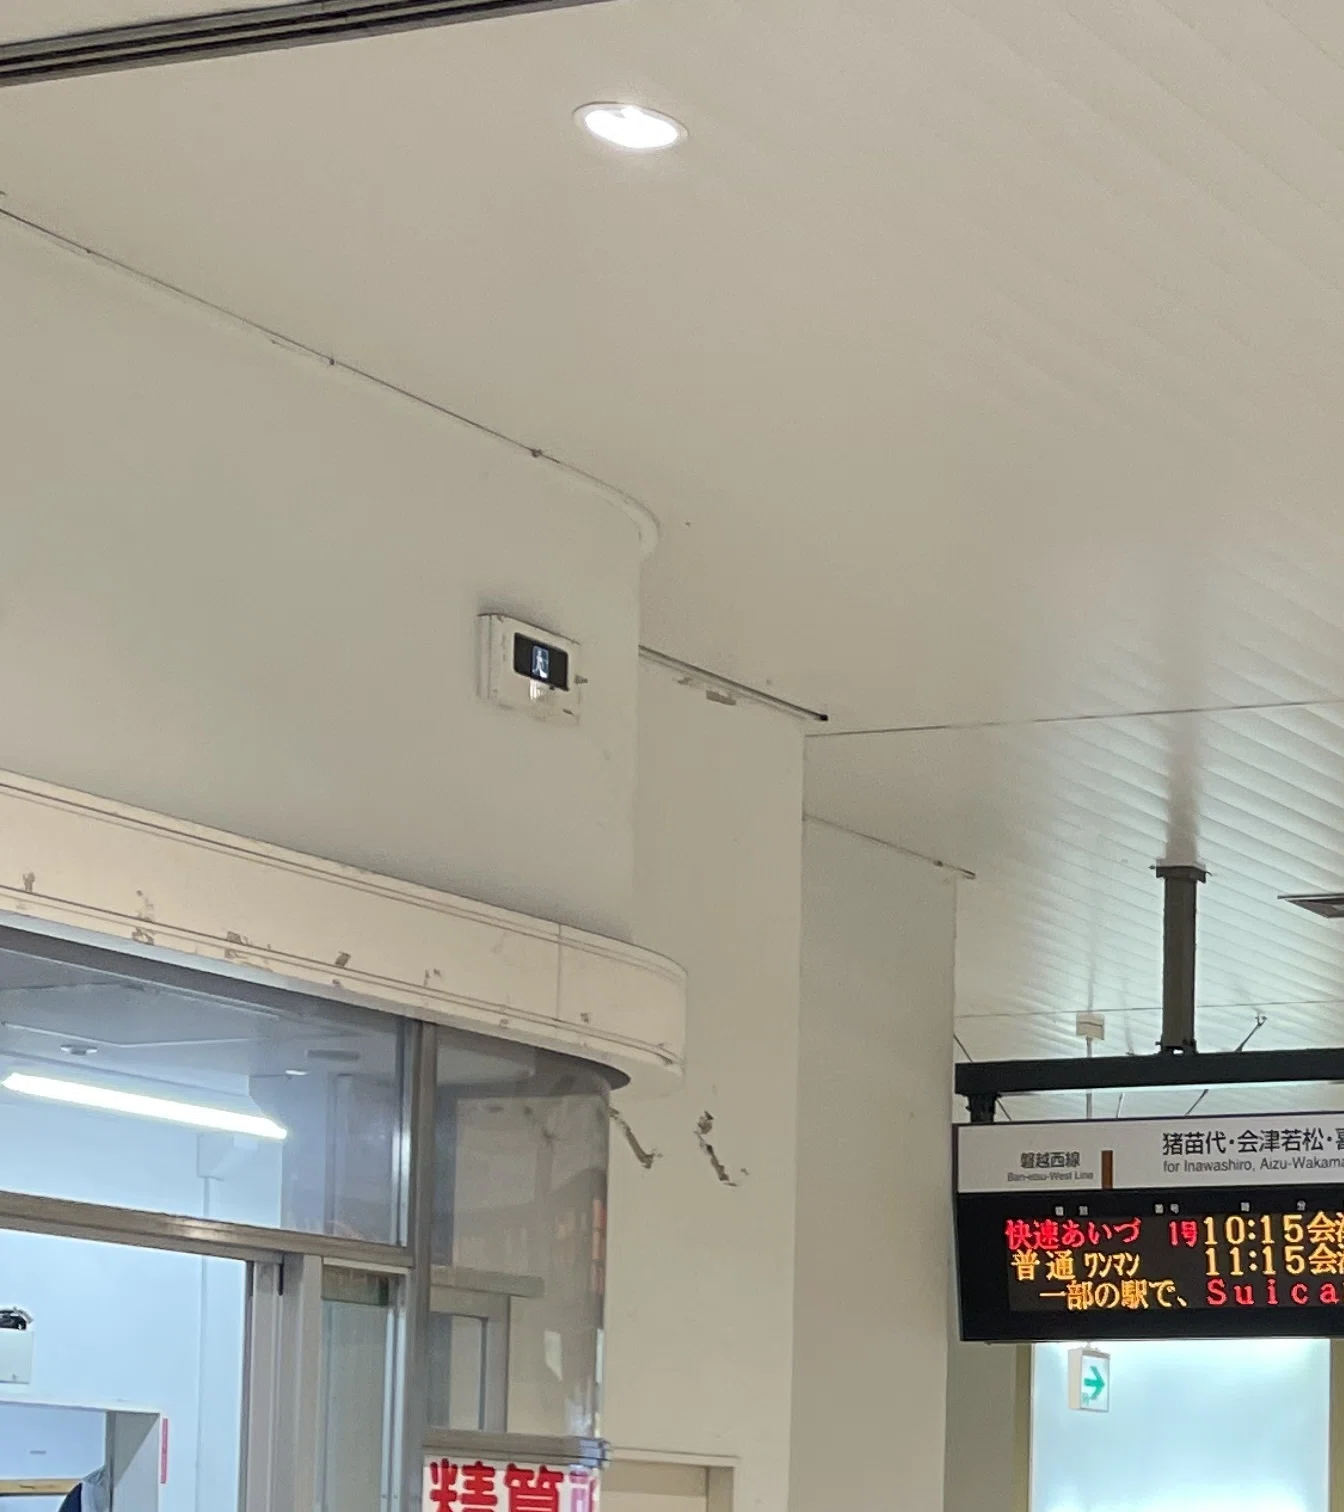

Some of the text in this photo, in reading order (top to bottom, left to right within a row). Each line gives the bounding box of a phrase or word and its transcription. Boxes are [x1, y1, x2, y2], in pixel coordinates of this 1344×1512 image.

[1163, 1160, 1180, 1173] for
[1184, 1158, 1256, 1173] Inawashiro,
[1005, 1218, 1141, 1251] 快速あいづ
[1203, 1215, 1304, 1246] 10:15
[1011, 1251, 1077, 1283] 普通
[1204, 1246, 1305, 1277] 11:15
